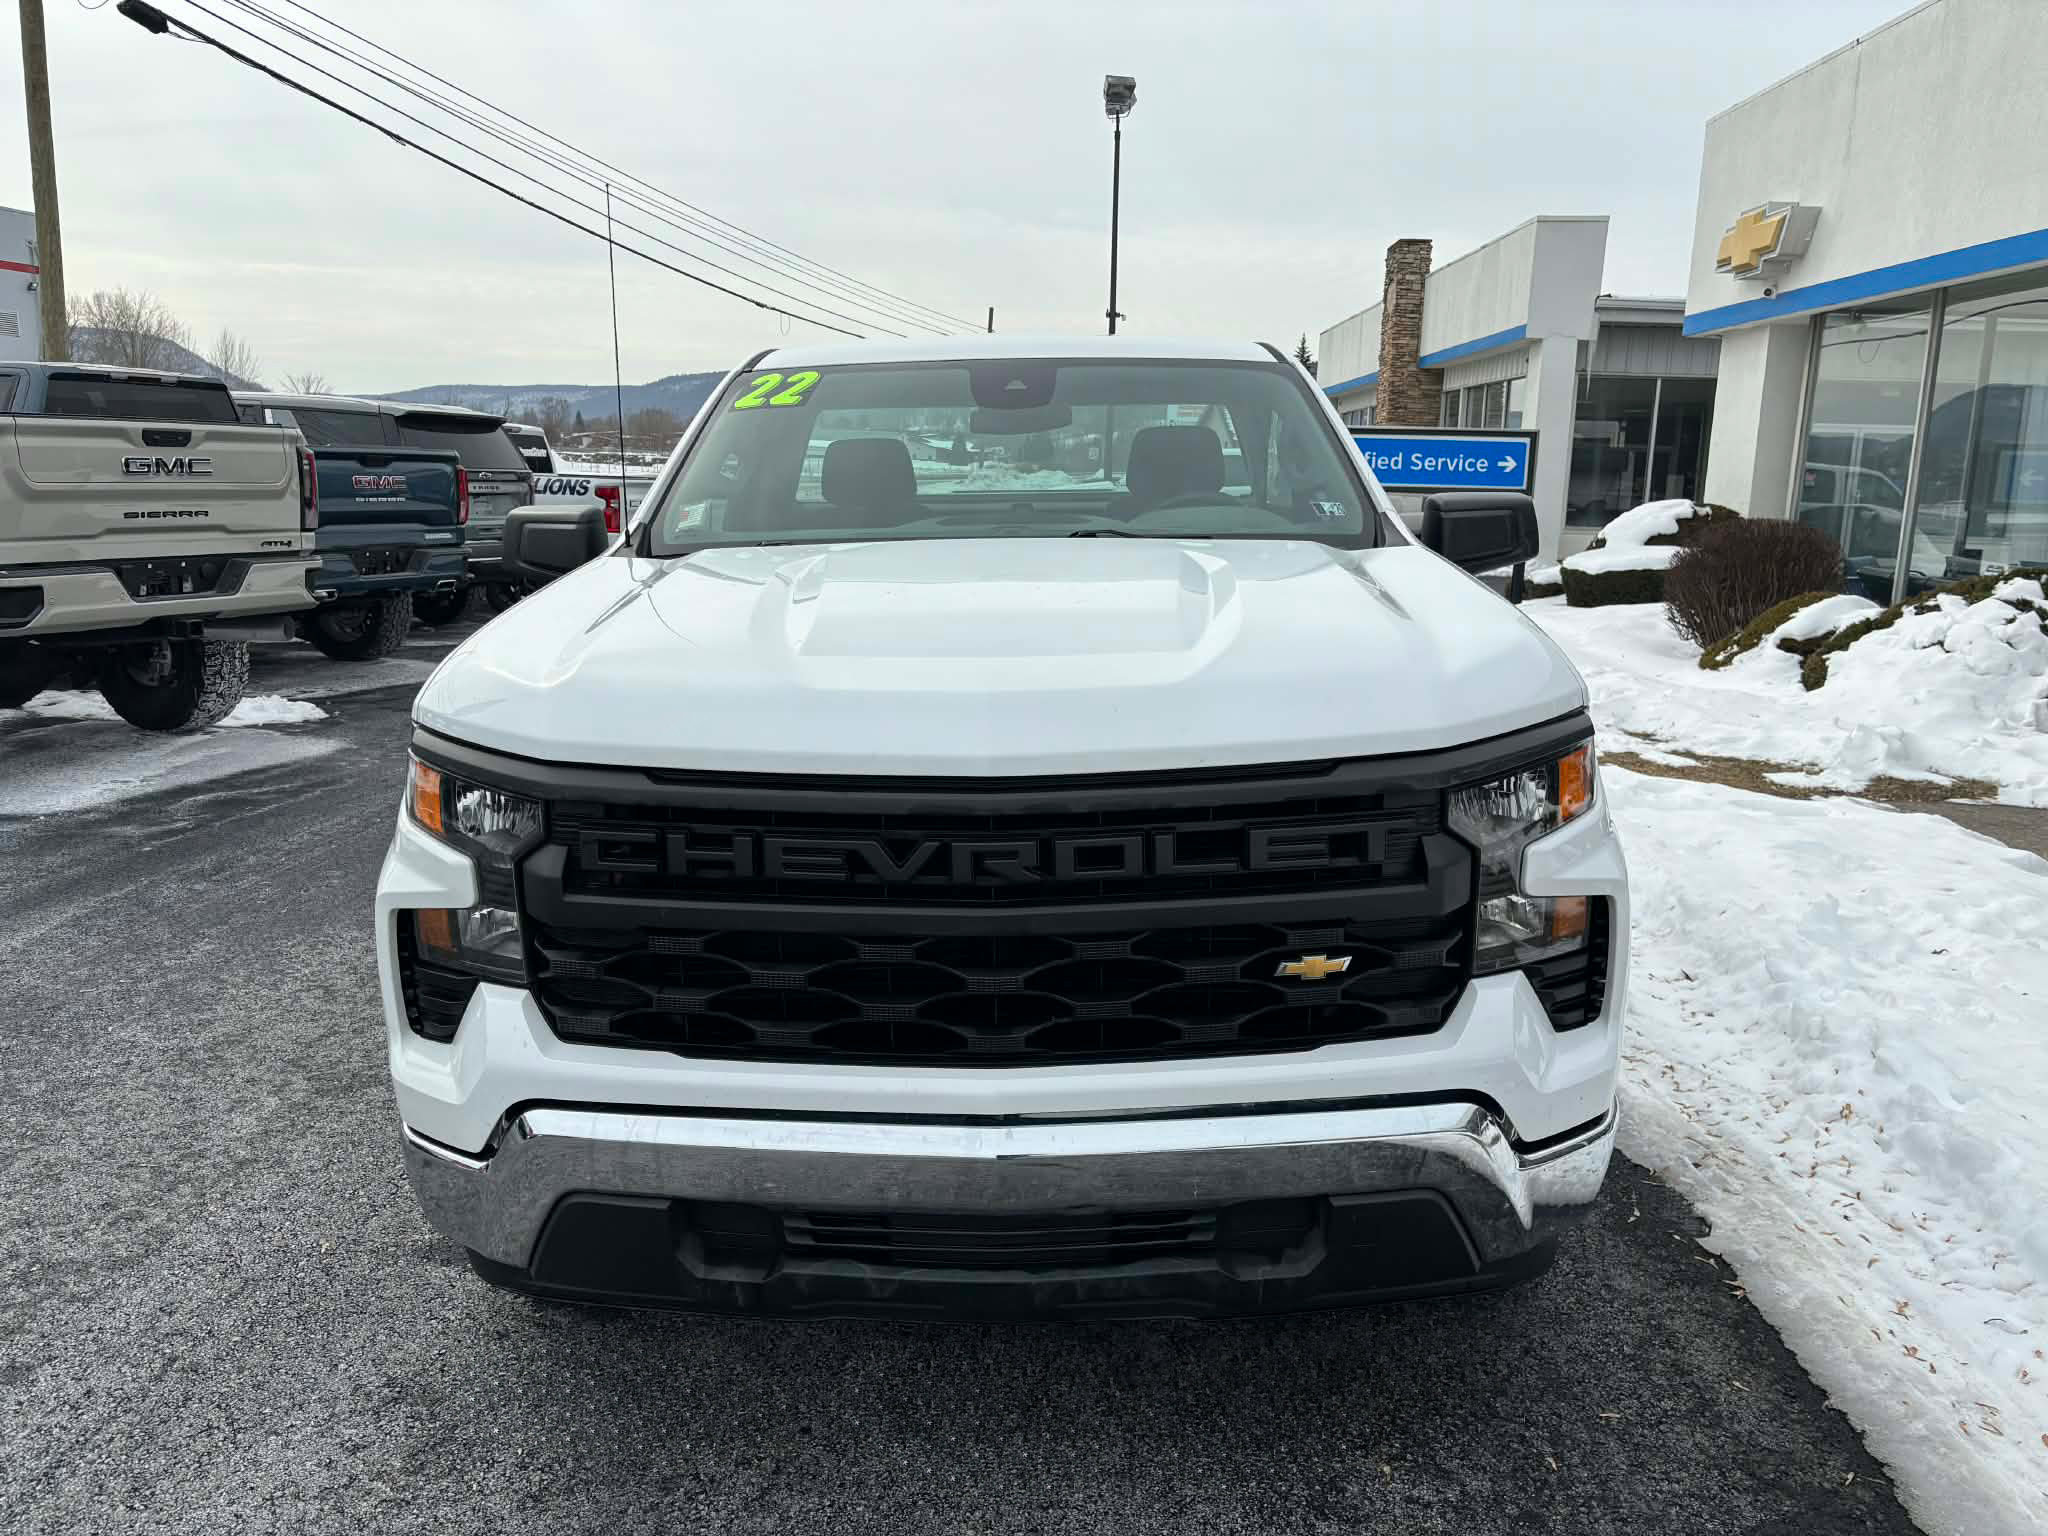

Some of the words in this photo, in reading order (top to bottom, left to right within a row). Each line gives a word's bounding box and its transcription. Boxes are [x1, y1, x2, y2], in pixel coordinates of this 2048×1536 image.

[734, 371, 820, 410] 22
[121, 456, 214, 476] GMC
[1410, 453, 1489, 473] Service
[352, 475, 408, 490] GMC
[534, 478, 591, 496] LIONS
[123, 510, 209, 519] SIERRA
[578, 819, 1406, 883] CHEVROLET
